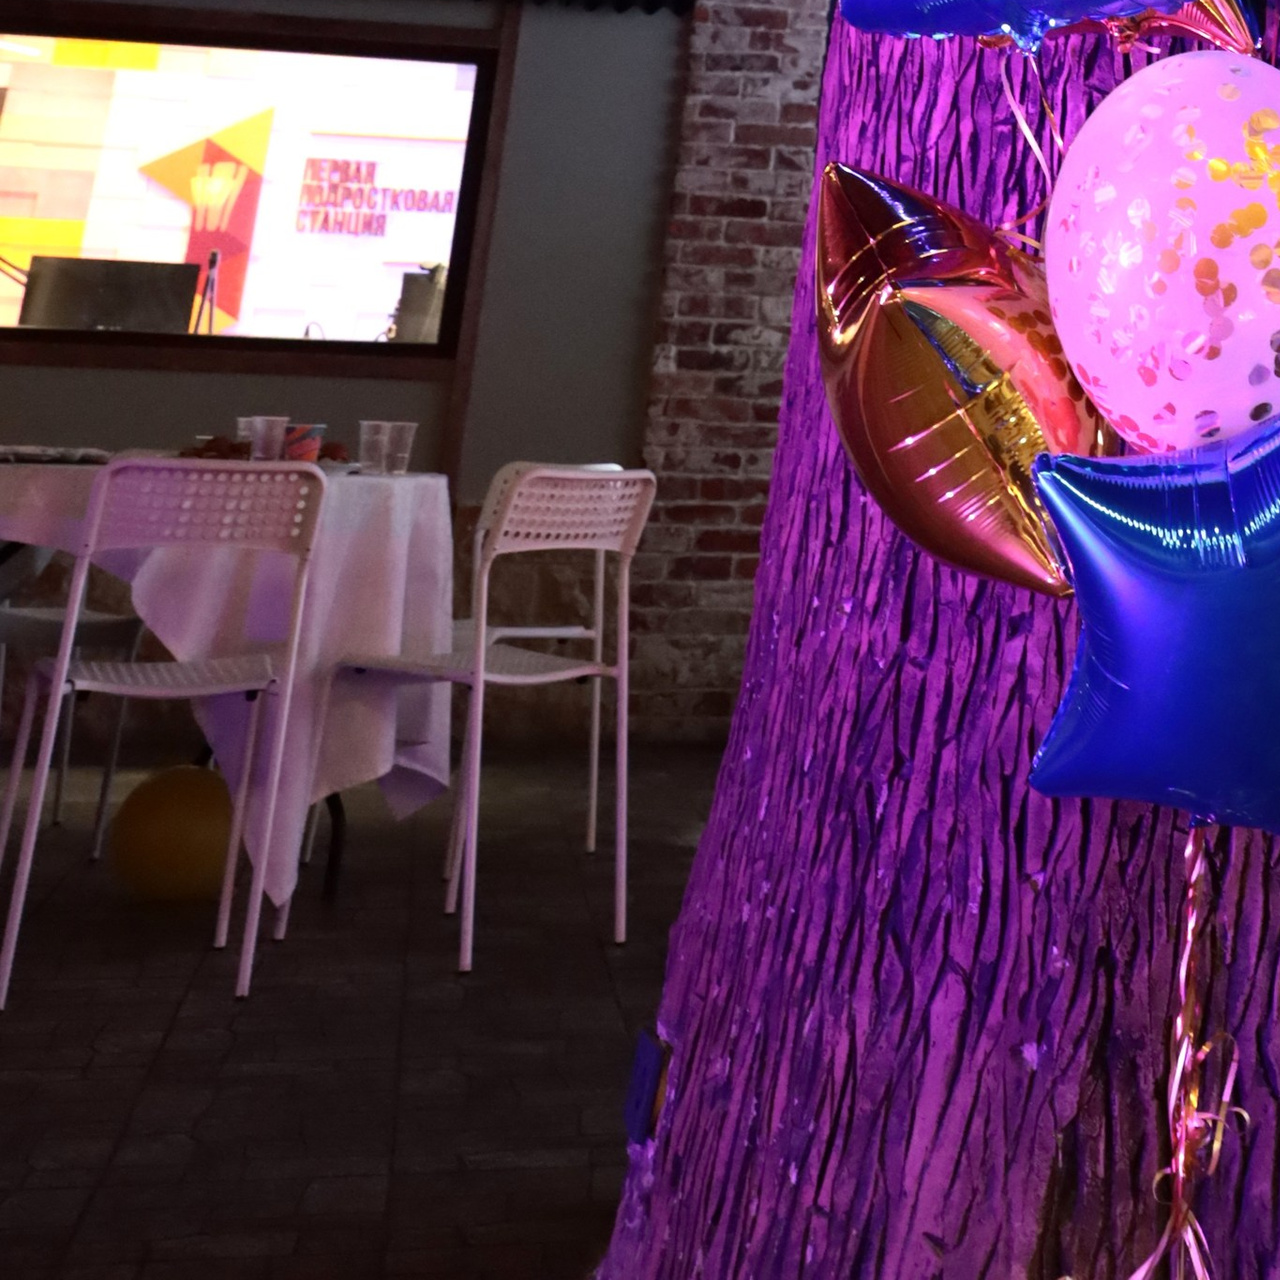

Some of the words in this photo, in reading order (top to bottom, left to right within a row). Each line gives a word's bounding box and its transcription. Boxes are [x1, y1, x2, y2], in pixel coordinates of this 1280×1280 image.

[303, 157, 376, 184] ПЕРВАЯ
[300, 183, 454, 213] ПОДРОСТКОВАЯ
[296, 210, 387, 236] СТАНЦИЯ
